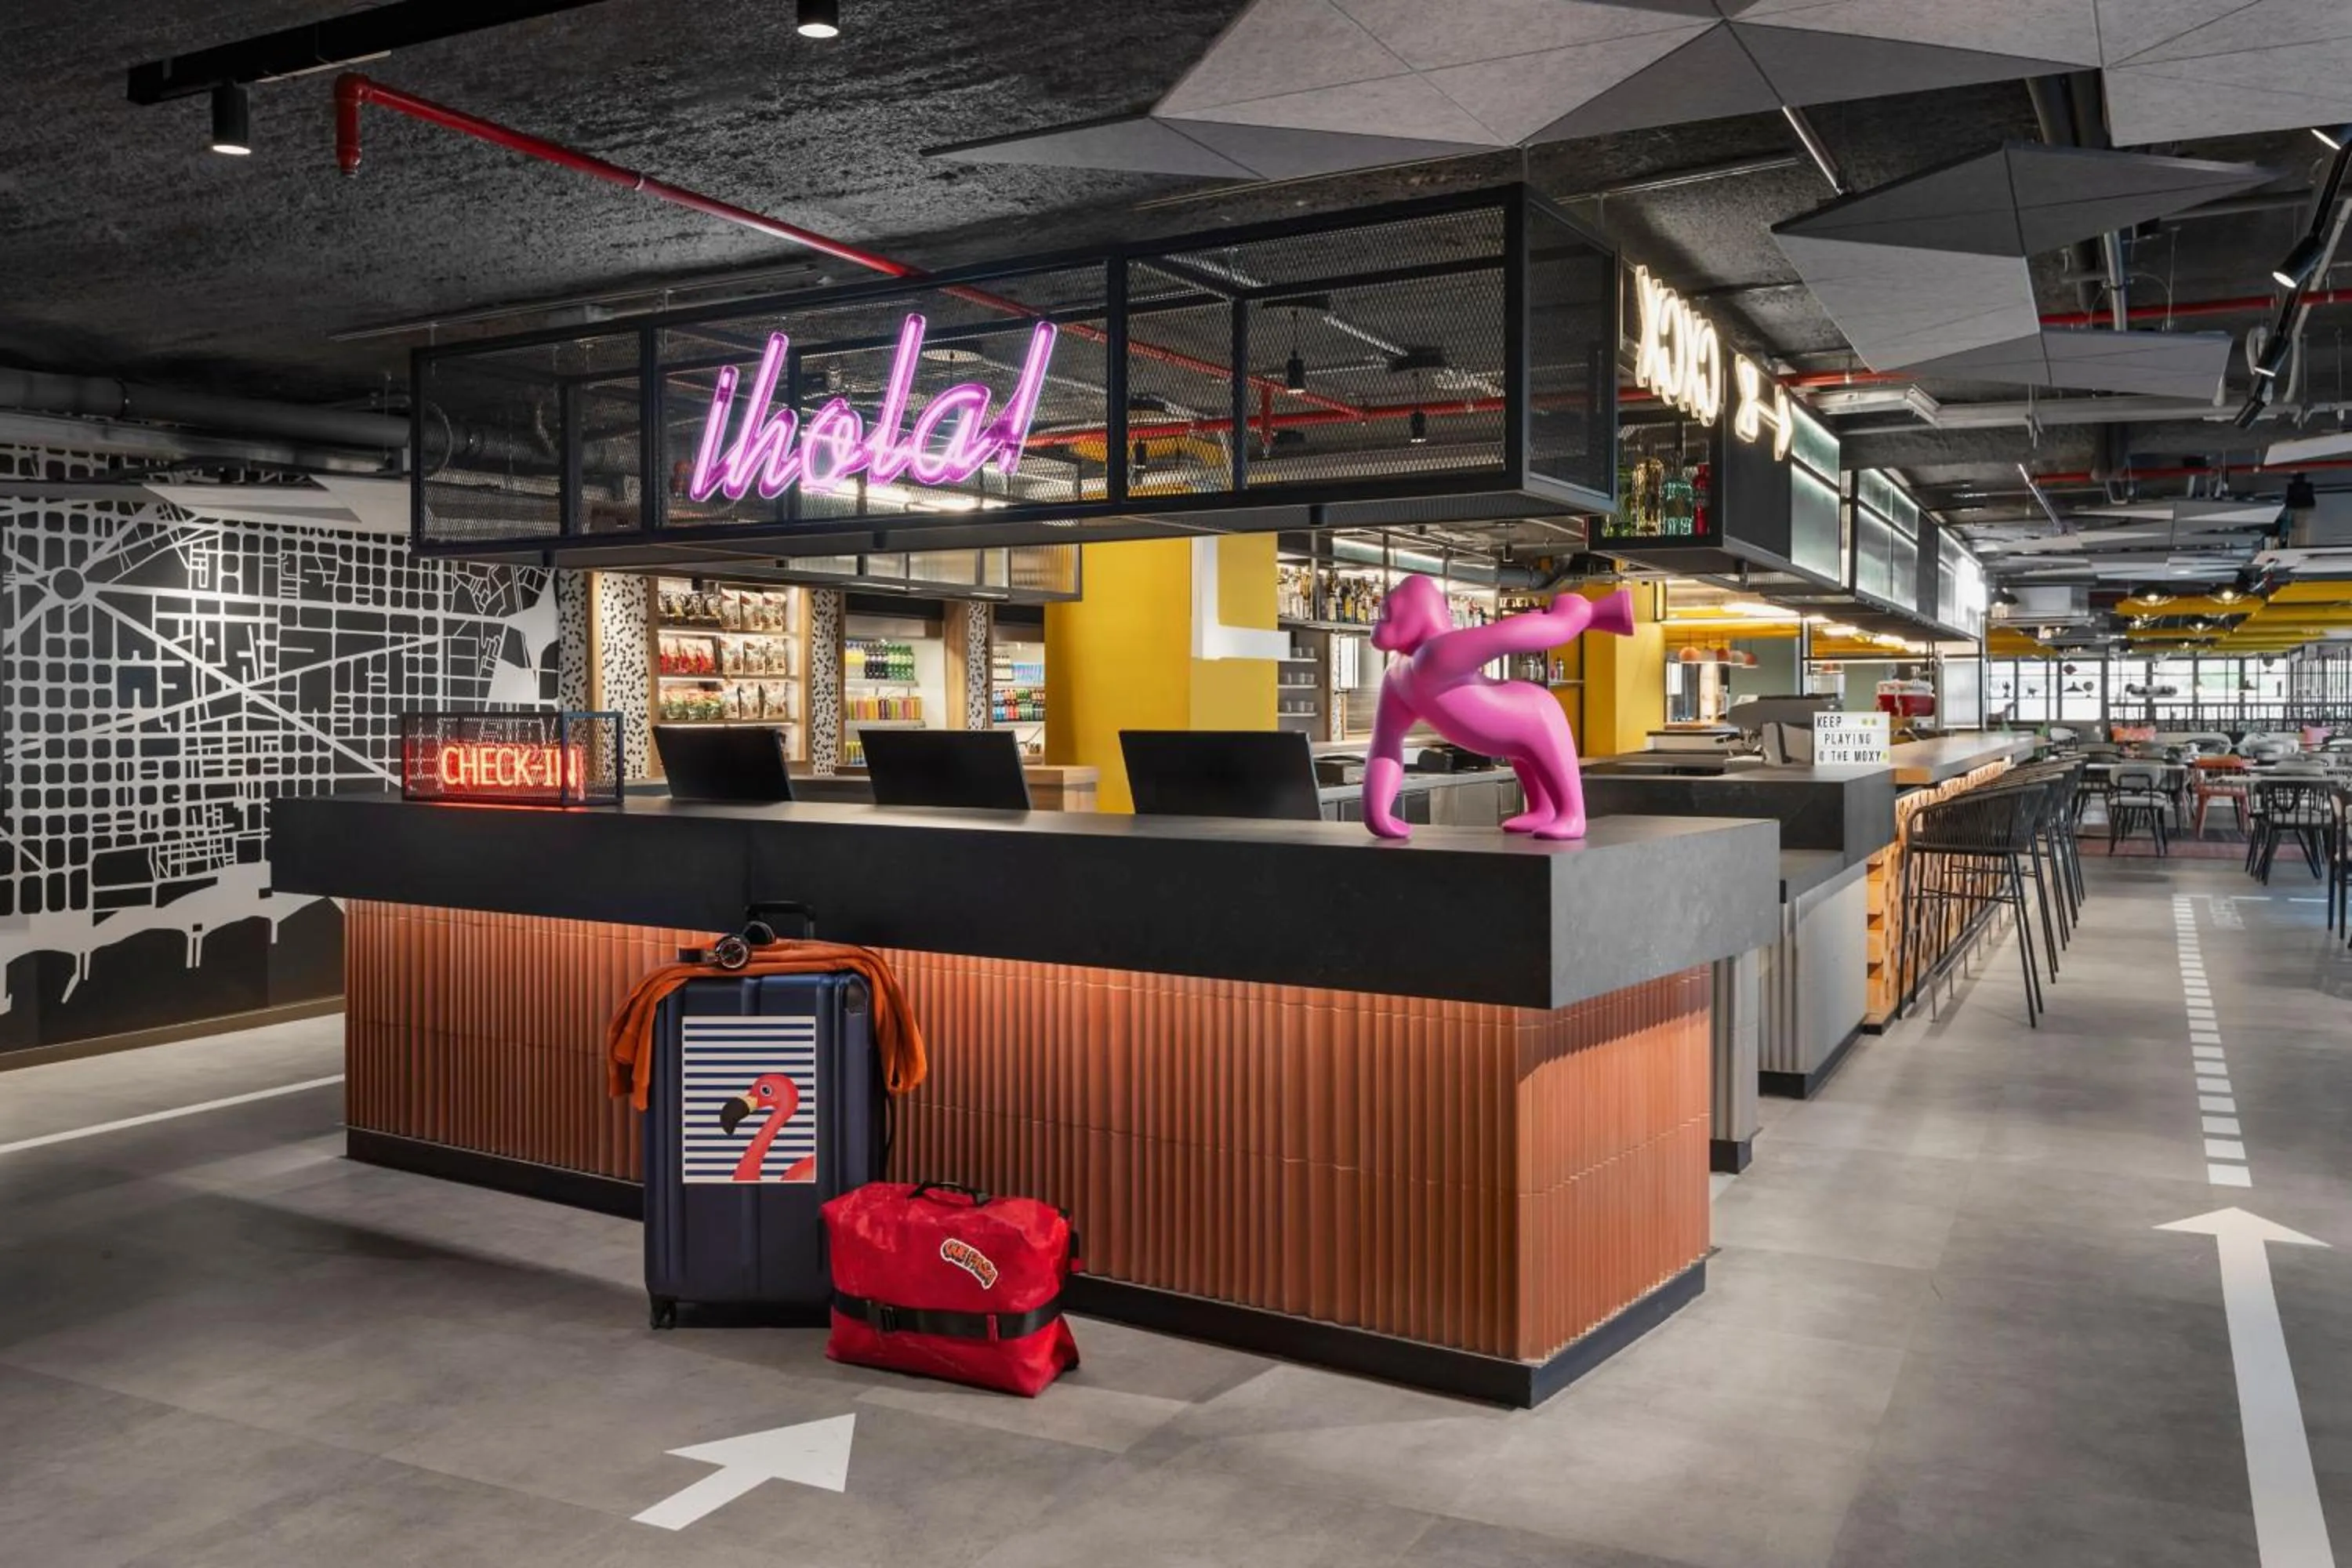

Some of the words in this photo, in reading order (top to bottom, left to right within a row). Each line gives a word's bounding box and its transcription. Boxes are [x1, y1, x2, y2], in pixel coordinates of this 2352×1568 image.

[1817, 716, 1842, 728] KEEP
[1824, 733, 1871, 745] PLAYING
[1831, 750, 1849, 762] THE
[1854, 750, 1881, 762] MOXY
[441, 744, 578, 789] CHECK-IN
